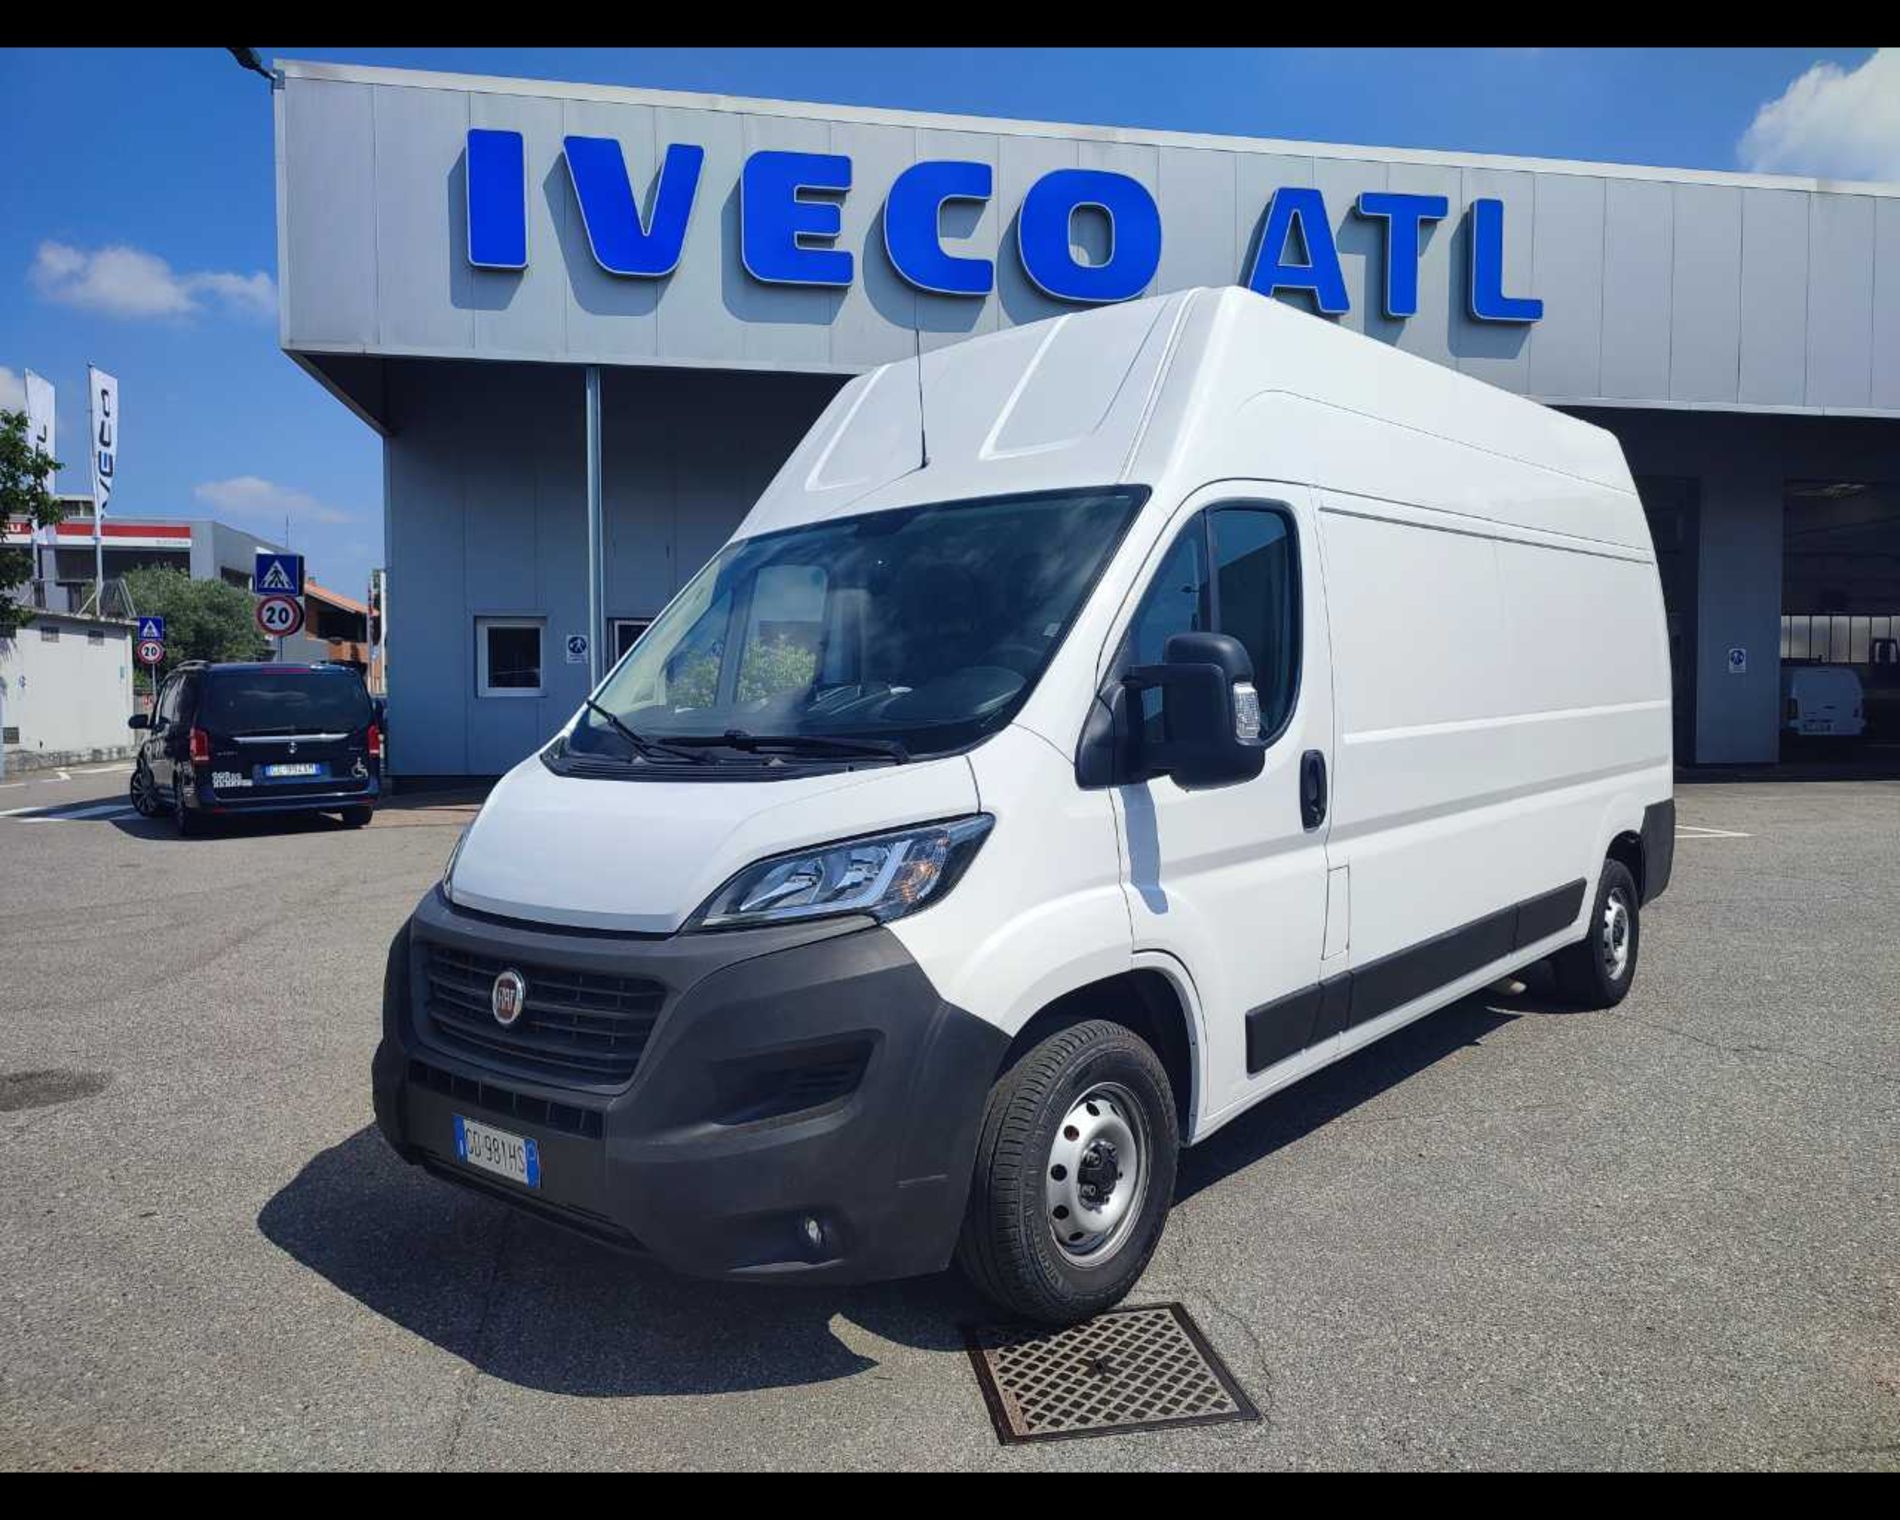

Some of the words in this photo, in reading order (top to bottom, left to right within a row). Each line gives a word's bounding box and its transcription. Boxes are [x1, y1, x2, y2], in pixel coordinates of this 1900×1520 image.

[466, 127, 1162, 302] IVECO
[1246, 186, 1544, 323] ATL
[98, 388, 114, 521] VECO
[143, 646, 158, 657] 20
[265, 606, 290, 624] 20
